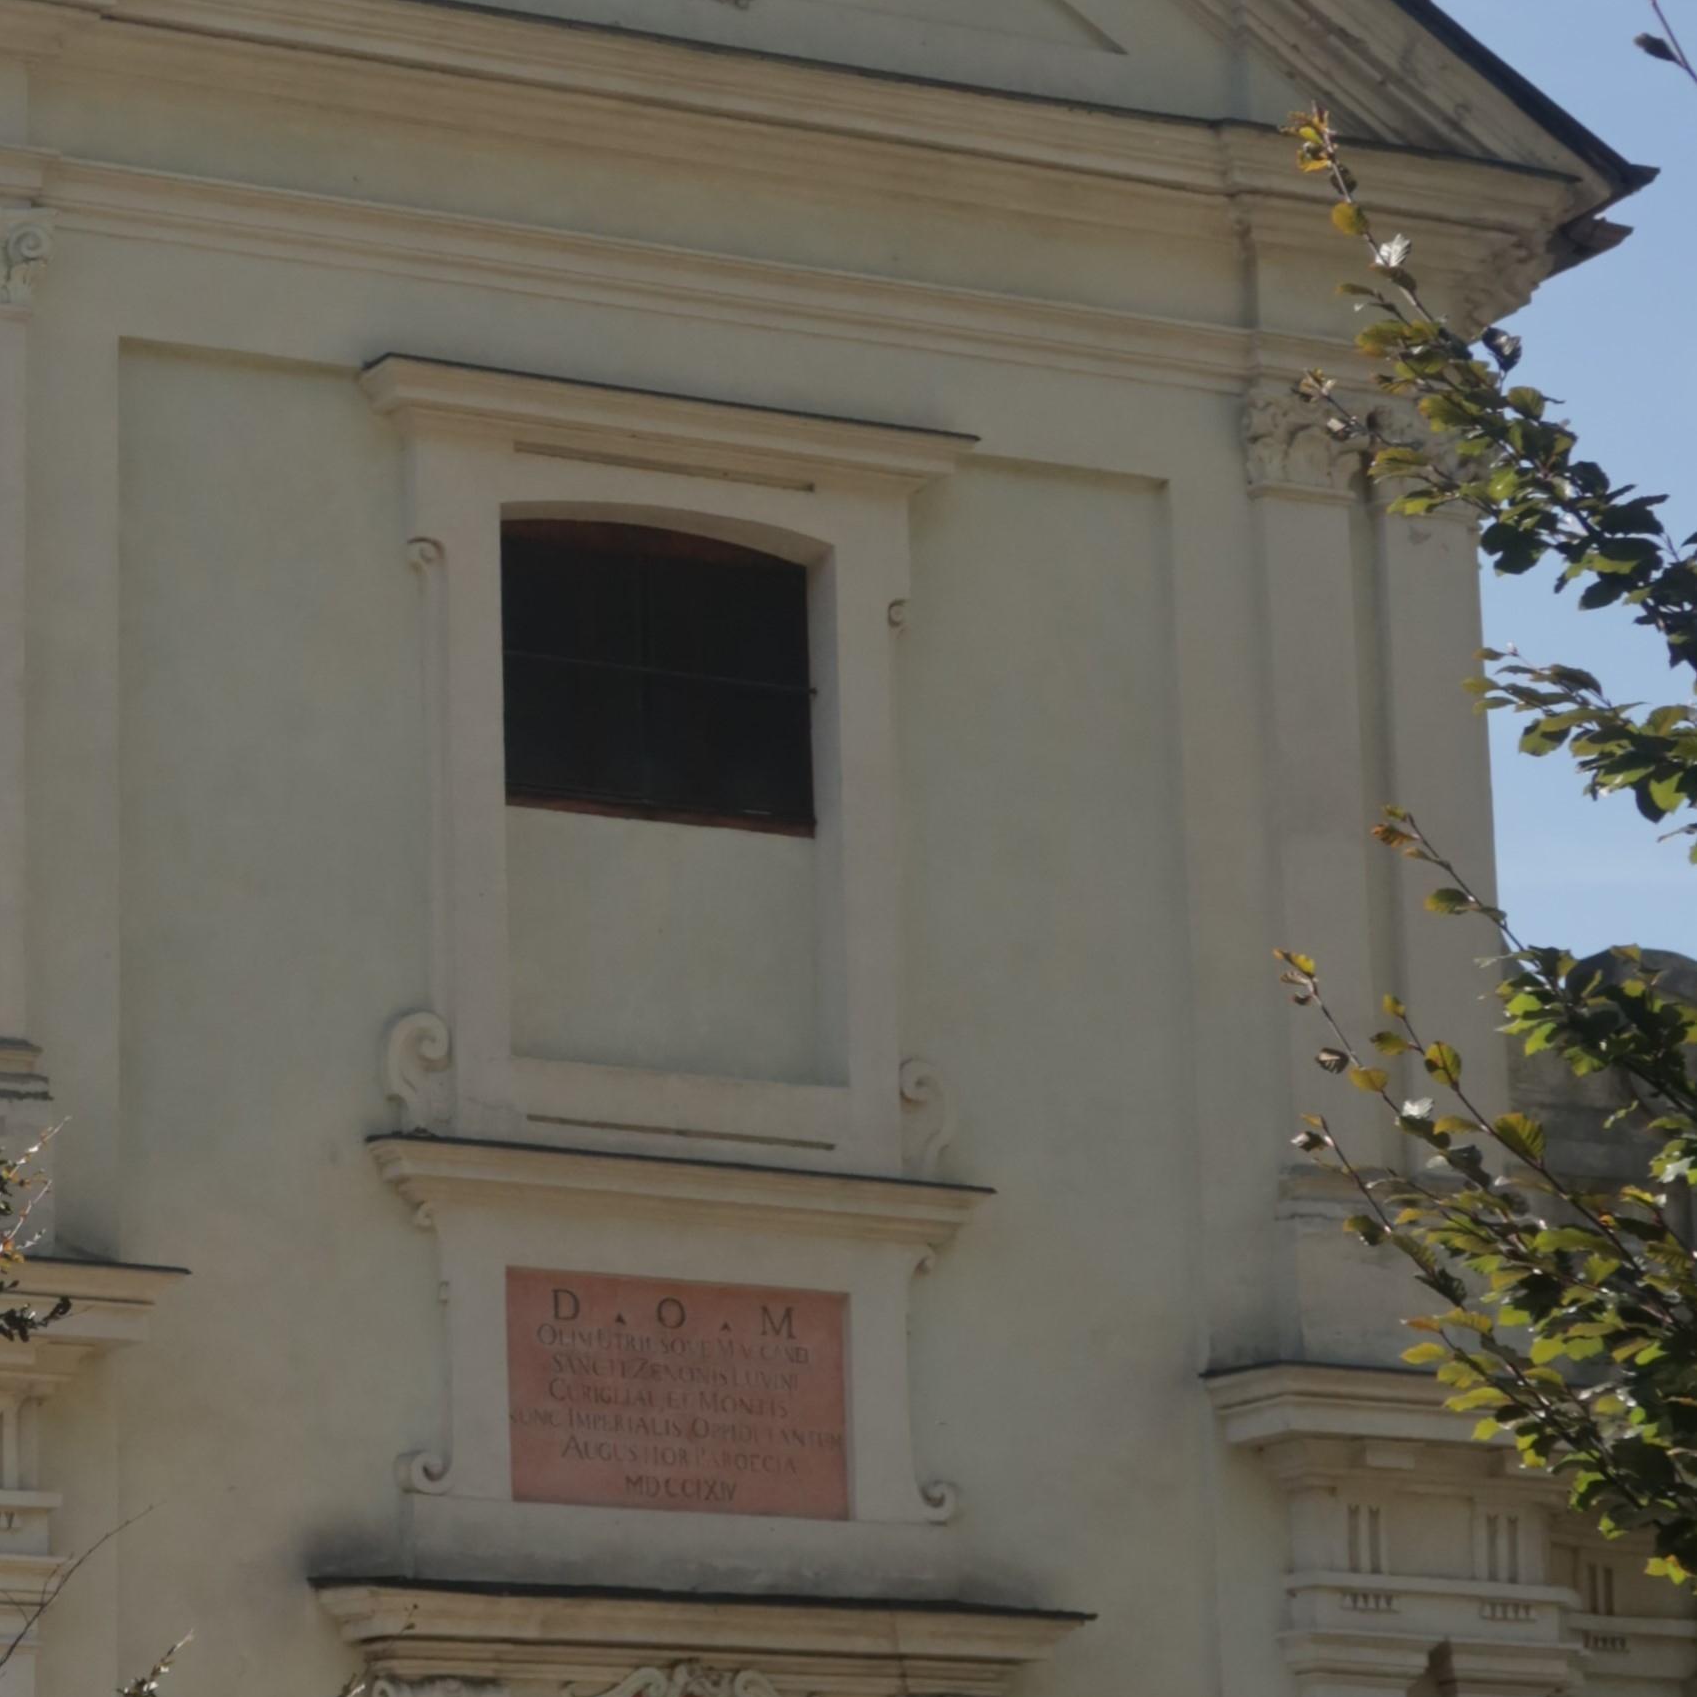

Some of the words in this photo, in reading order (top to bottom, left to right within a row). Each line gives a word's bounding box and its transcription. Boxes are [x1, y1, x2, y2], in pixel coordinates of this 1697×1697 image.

[552, 1289, 581, 1321] D
[656, 1297, 687, 1329] O
[760, 1305, 797, 1340] M
